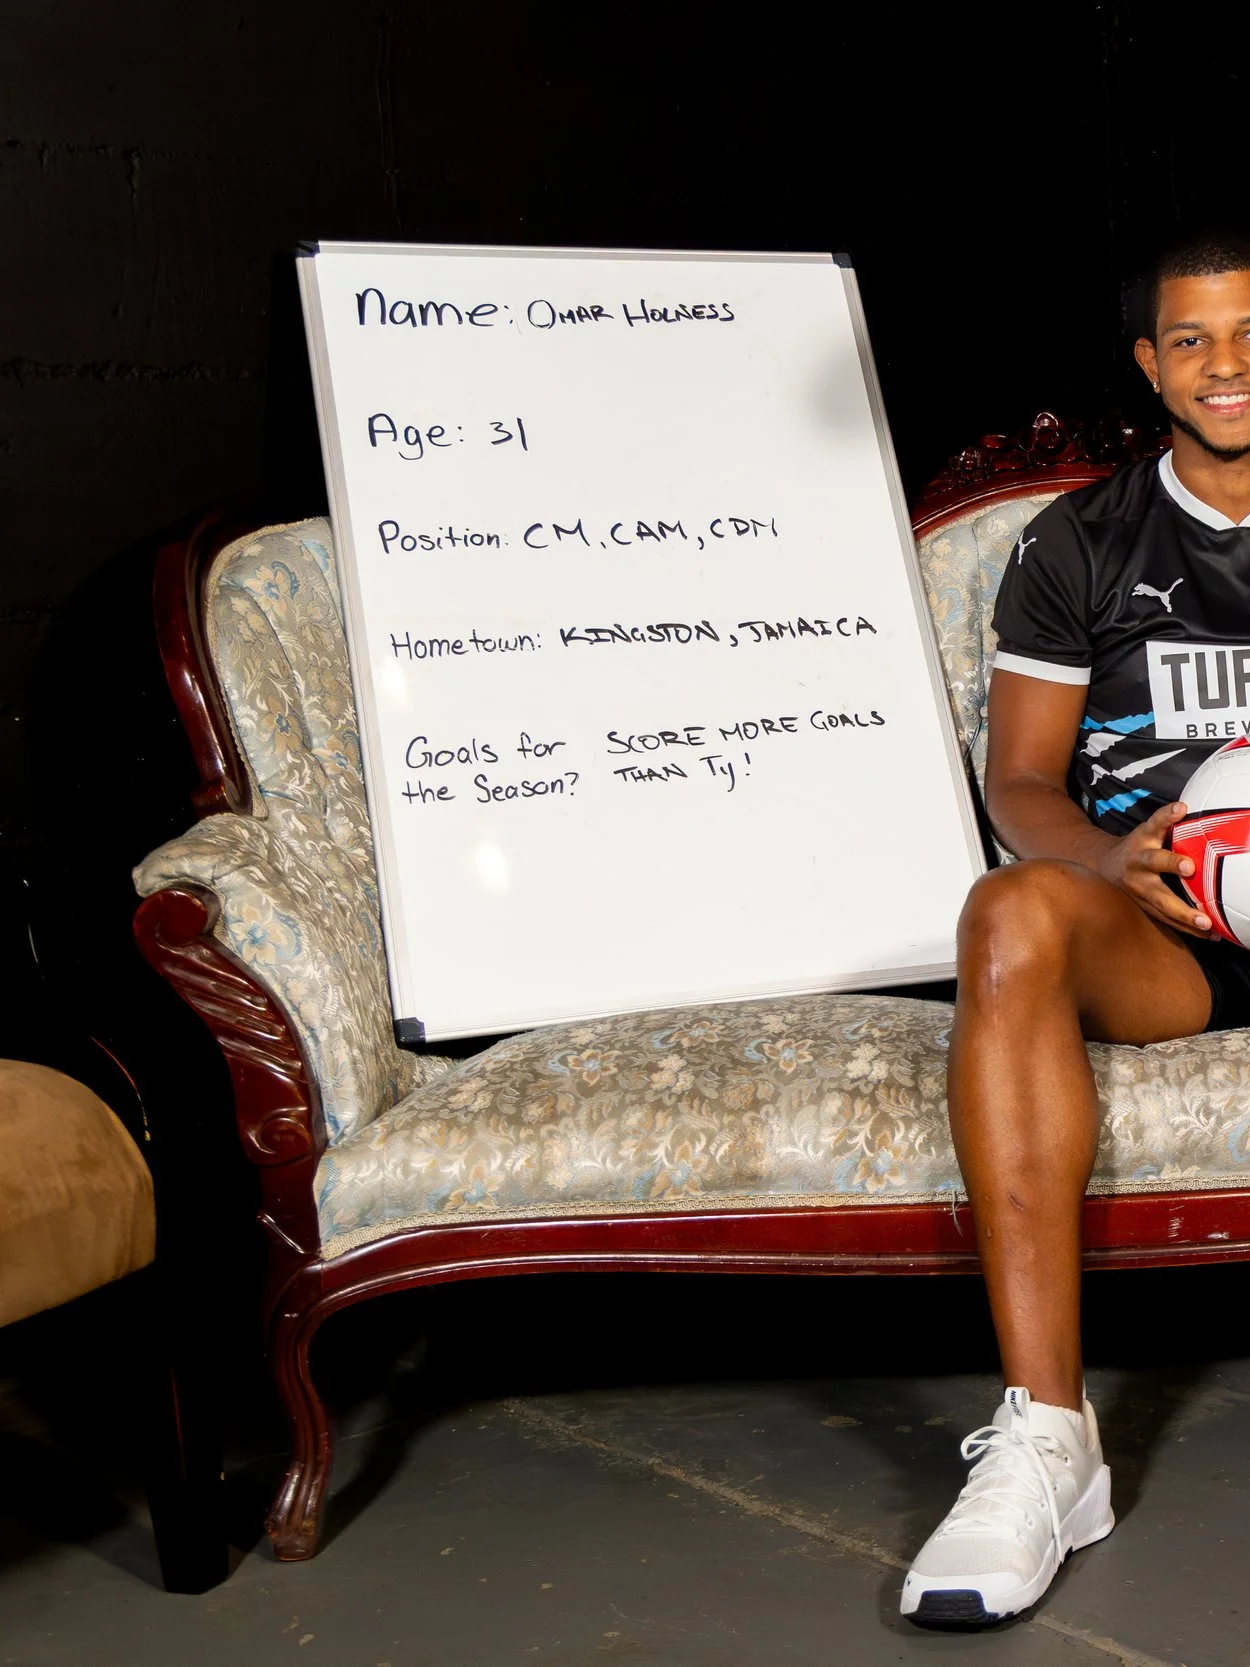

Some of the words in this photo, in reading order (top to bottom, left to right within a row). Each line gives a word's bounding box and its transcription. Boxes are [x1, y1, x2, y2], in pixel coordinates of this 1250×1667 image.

[356, 288, 513, 328] Name:
[368, 413, 464, 461] Age:
[489, 417, 528, 451] 31
[378, 519, 508, 554] Position:
[390, 628, 542, 660] Hometown:
[738, 616, 877, 643] JAMAICA
[405, 736, 499, 769] Goals
[516, 731, 567, 759] for
[606, 726, 706, 754] SCORE
[718, 716, 799, 741] MORE
[810, 710, 886, 731] GOALS
[401, 780, 456, 804] the
[474, 772, 579, 804] Season?
[613, 763, 688, 783] THAN
